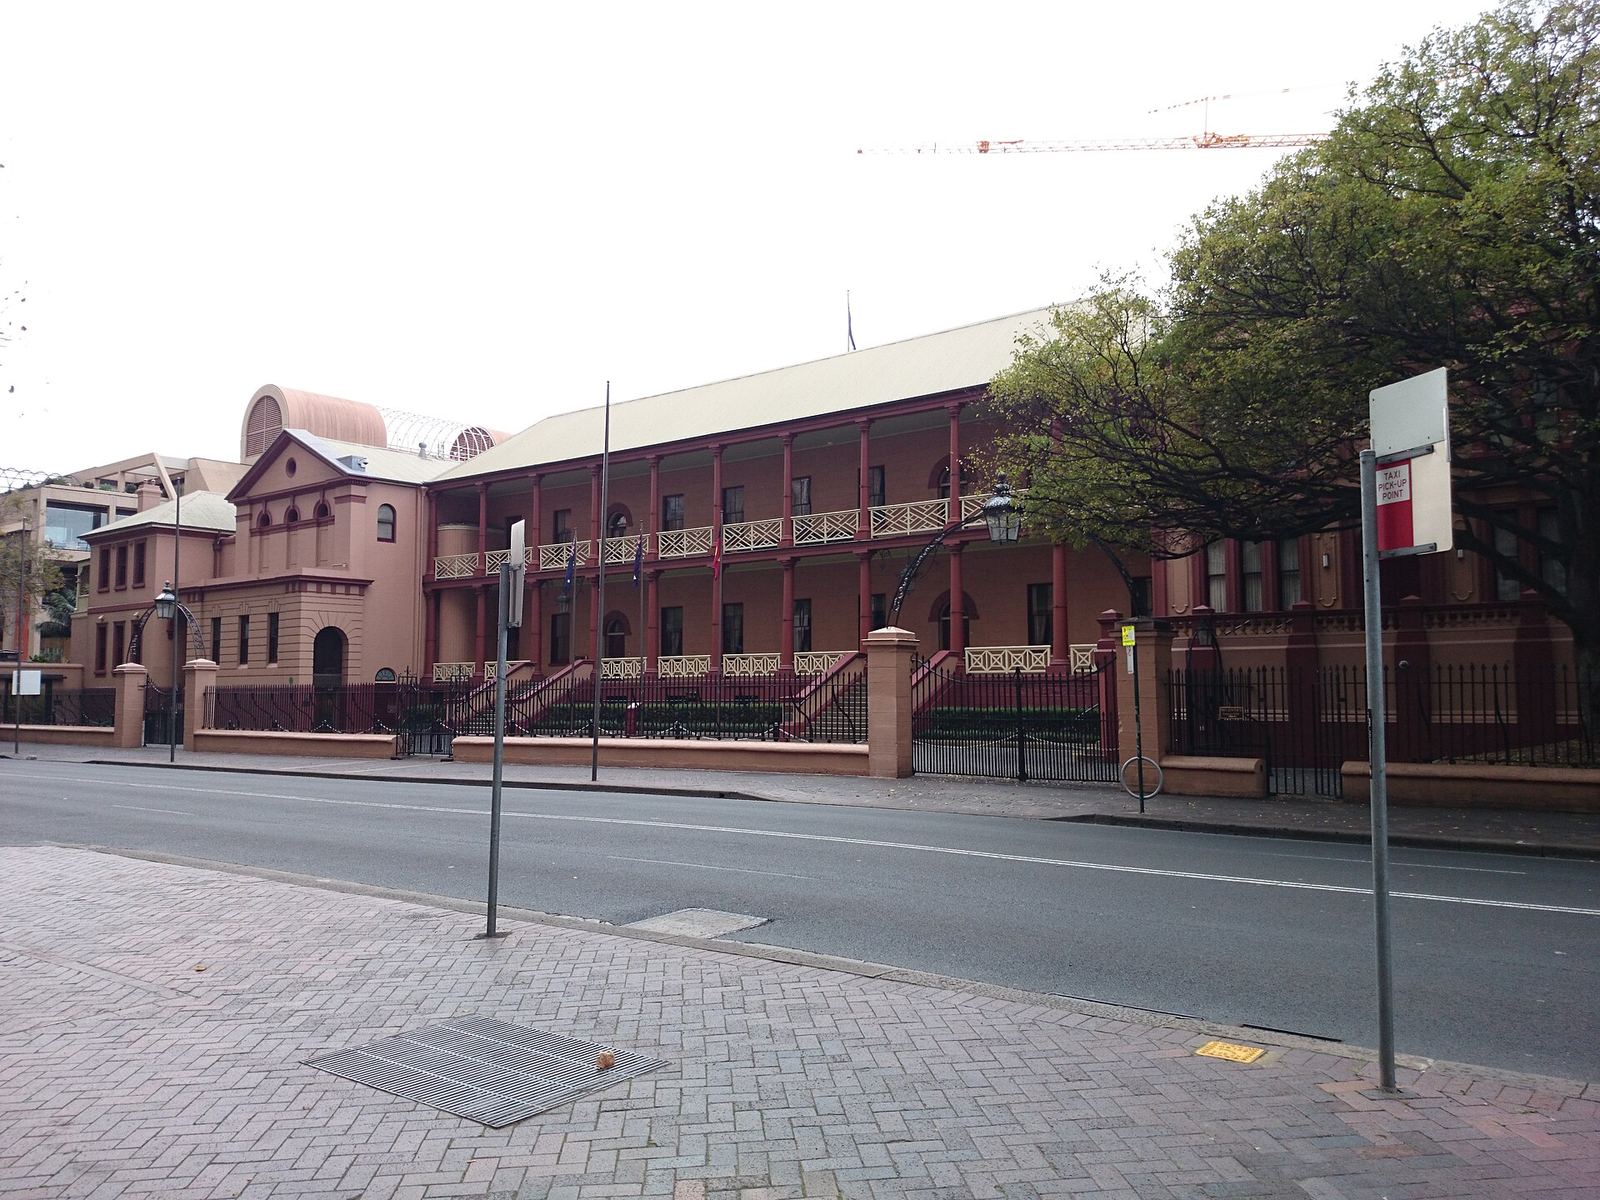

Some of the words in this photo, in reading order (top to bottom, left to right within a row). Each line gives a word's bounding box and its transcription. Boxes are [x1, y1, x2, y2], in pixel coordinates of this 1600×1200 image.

[1384, 470, 1401, 480] TAXI
[1378, 479, 1407, 491] PICK-UP
[1383, 489, 1403, 500] POINT
